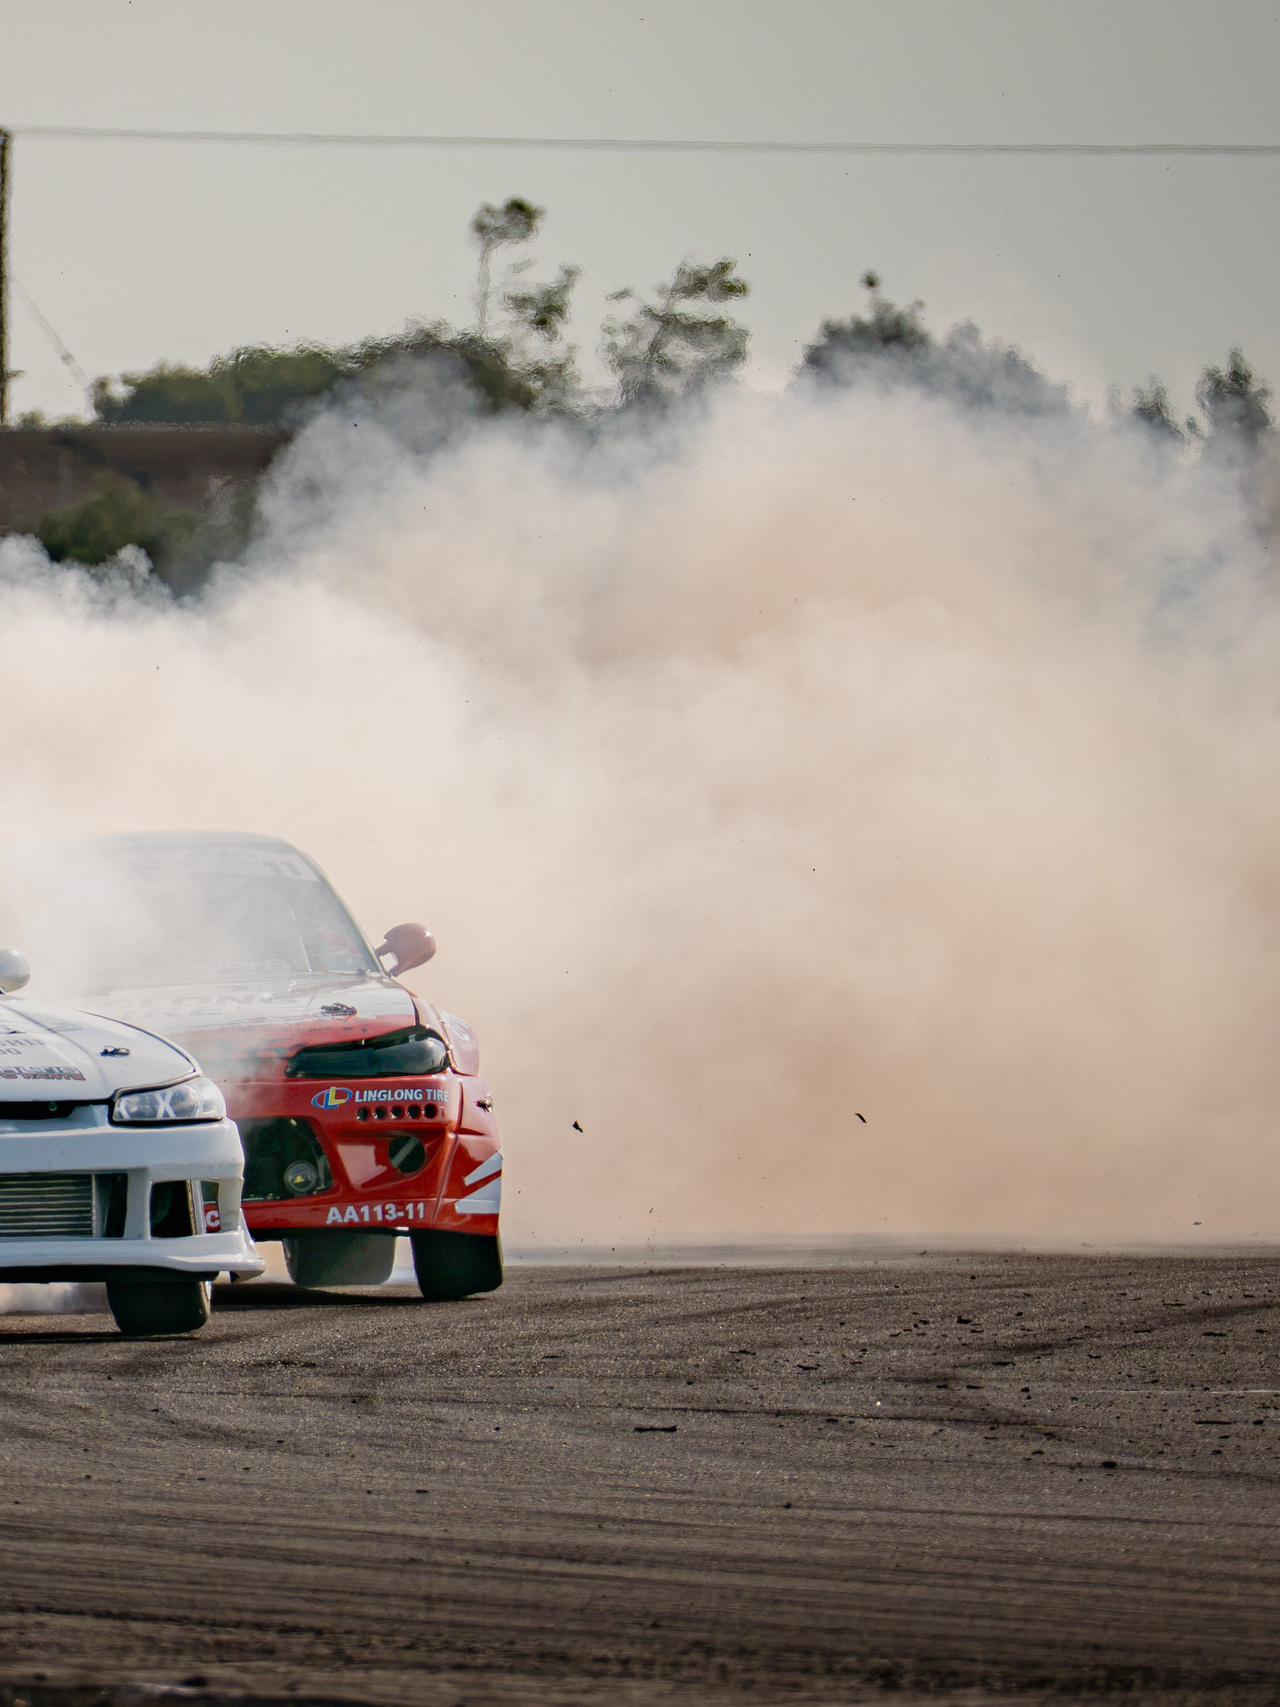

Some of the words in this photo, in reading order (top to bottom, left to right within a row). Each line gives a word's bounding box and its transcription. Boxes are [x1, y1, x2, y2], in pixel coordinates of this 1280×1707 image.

[354, 1088, 423, 1103] LINGLONG
[426, 1088, 450, 1102] TIRE
[326, 1202, 425, 1224] AA113-11
